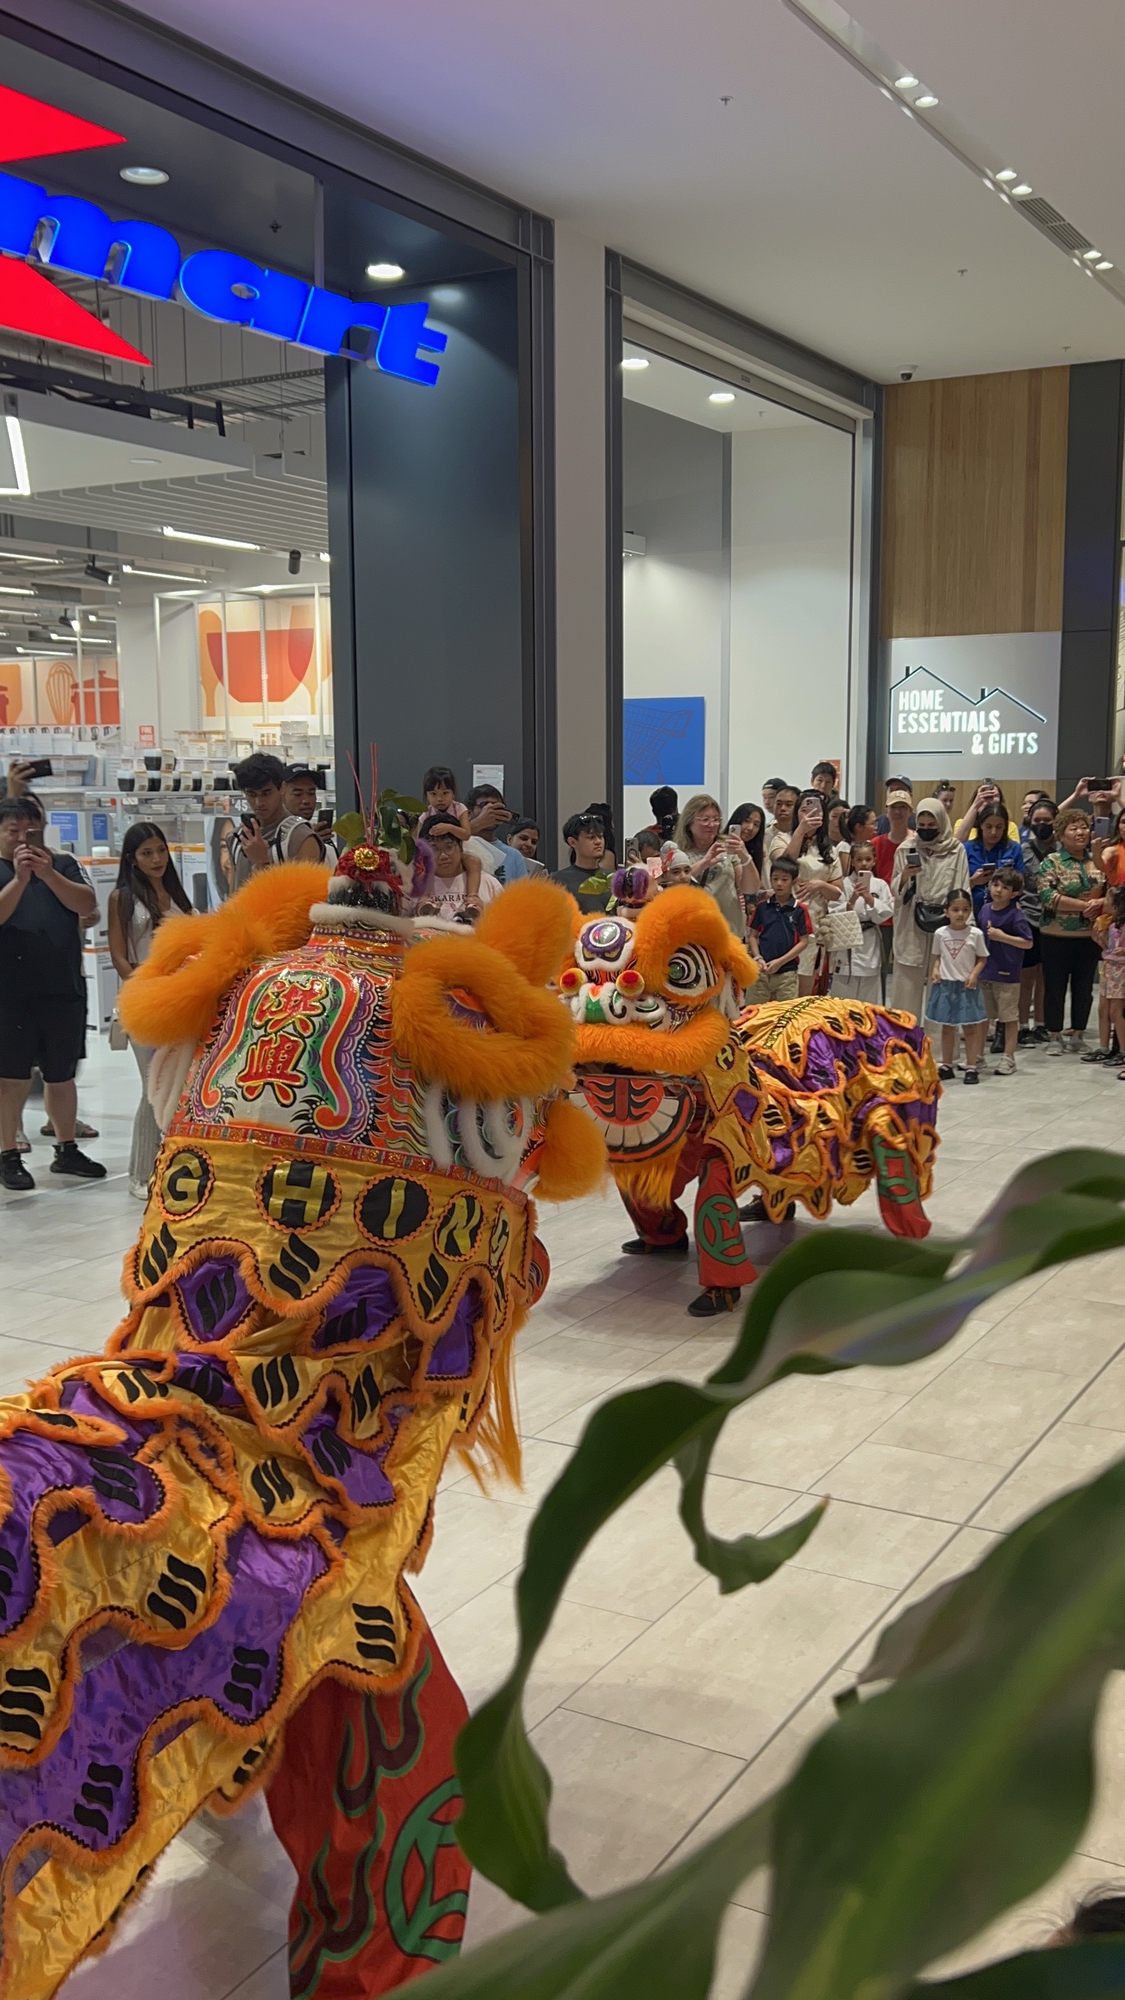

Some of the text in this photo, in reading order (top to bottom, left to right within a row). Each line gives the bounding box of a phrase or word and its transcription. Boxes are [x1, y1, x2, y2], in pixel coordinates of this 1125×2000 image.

[899, 689, 944, 711] HOME
[898, 710, 1001, 734] ESSENTIALS
[970, 732, 1039, 754] & GIFTS
